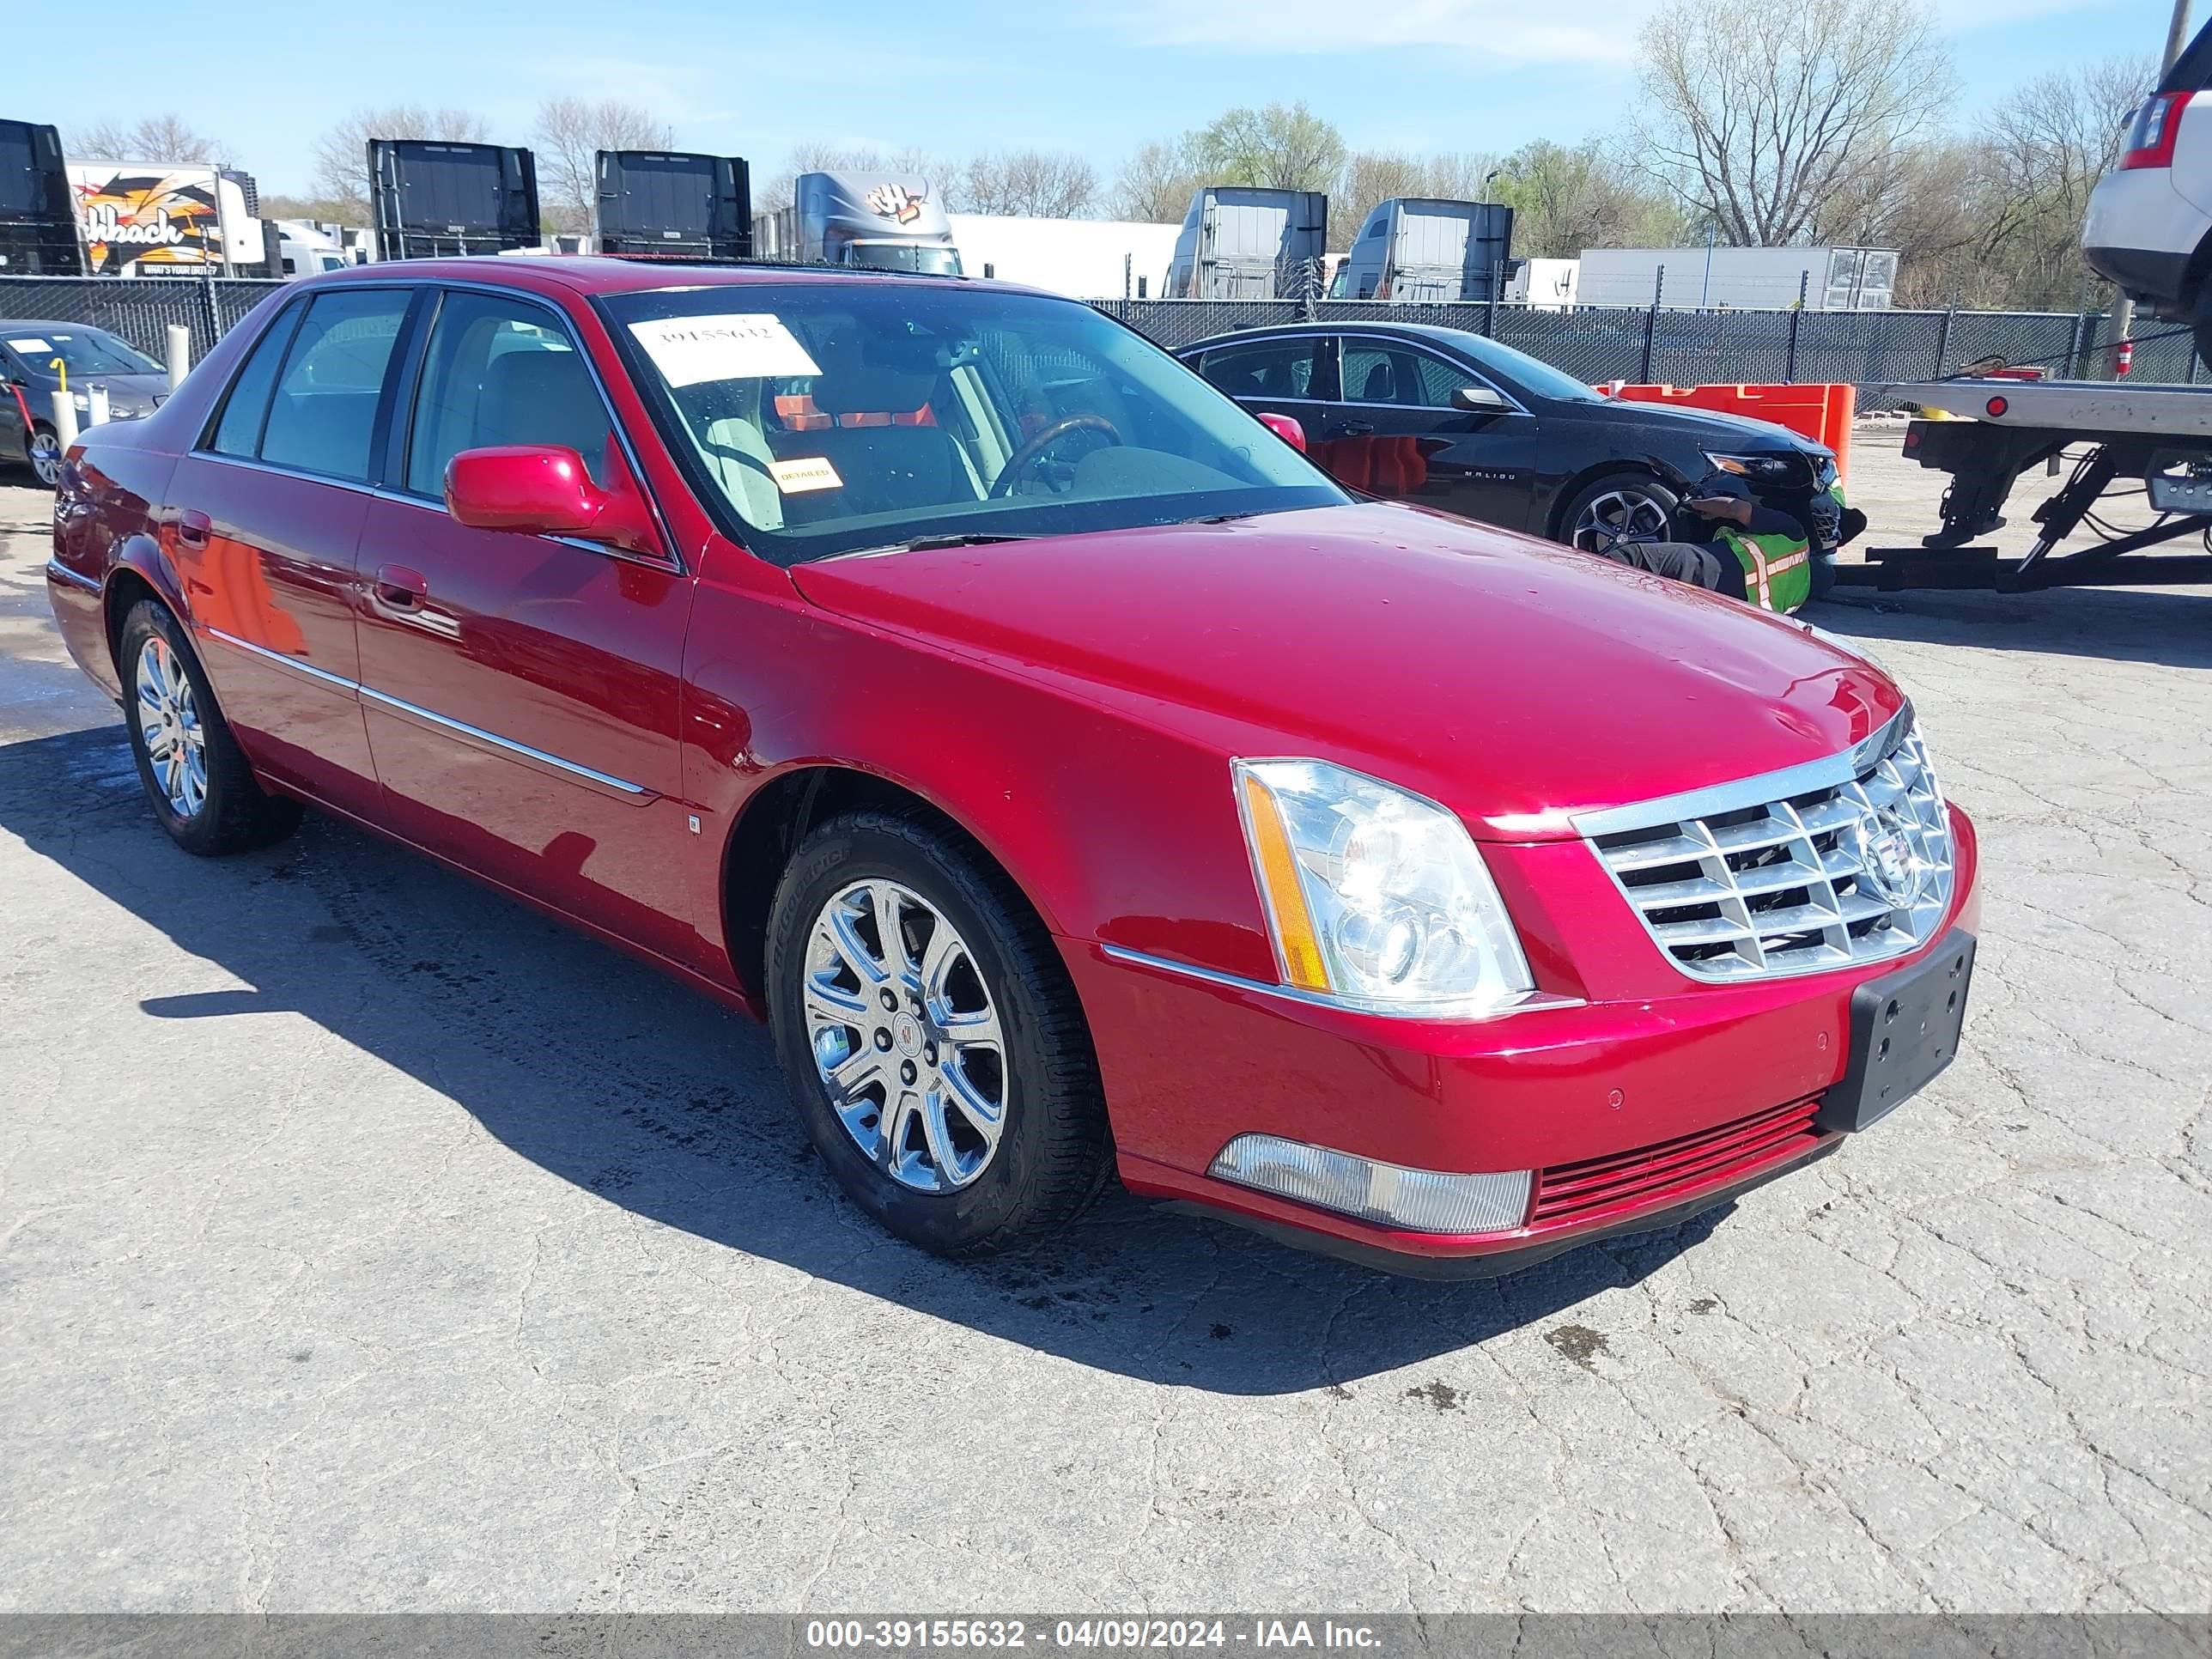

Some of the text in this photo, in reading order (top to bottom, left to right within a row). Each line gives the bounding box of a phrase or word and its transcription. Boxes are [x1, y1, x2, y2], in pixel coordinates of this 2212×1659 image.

[143, 264, 171, 275] WHAT'S
[172, 265, 189, 275] YOUR
[659, 328, 773, 345] 39155632
[781, 470, 830, 481] DETAILED
[1464, 471, 1516, 480] MALIBU
